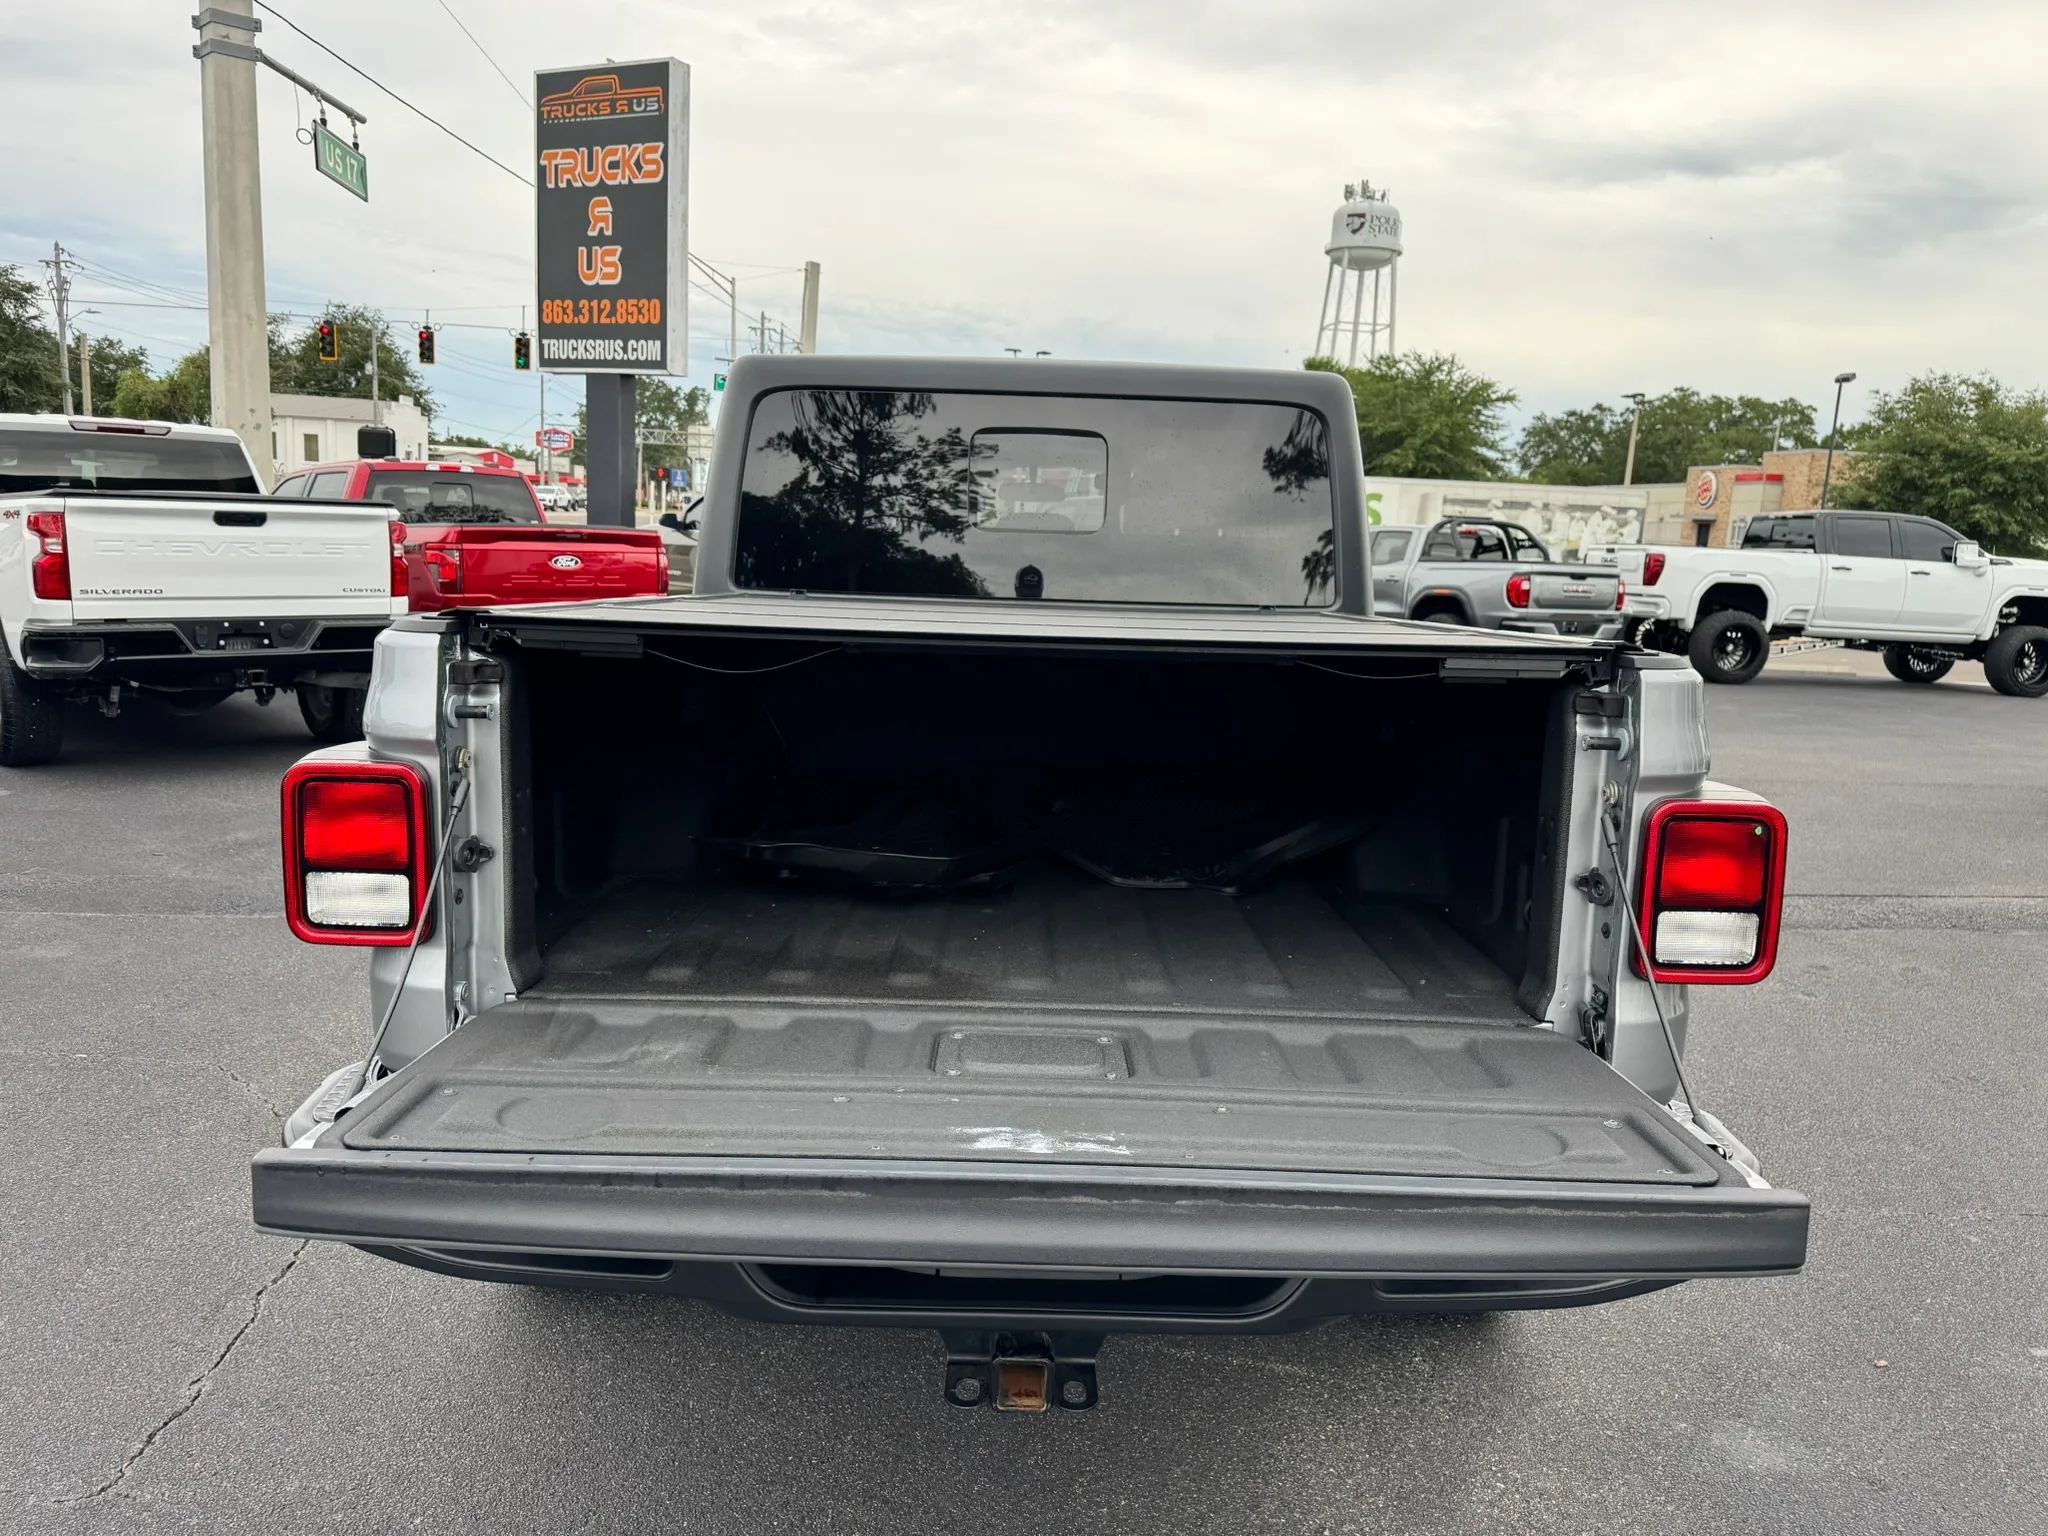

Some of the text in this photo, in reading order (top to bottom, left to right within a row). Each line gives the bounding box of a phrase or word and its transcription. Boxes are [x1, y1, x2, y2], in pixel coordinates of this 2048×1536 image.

[541, 101, 611, 119] TRUCKS
[633, 97, 659, 112] US
[325, 140, 358, 184] US 17
[540, 142, 664, 188] TRUCKS
[578, 246, 622, 286] US
[542, 299, 661, 325] 863.312.8530
[542, 338, 662, 361] TRUCKSRUS.COM
[94, 539, 371, 558] CHEVROLET
[79, 588, 164, 596] SILVERADO
